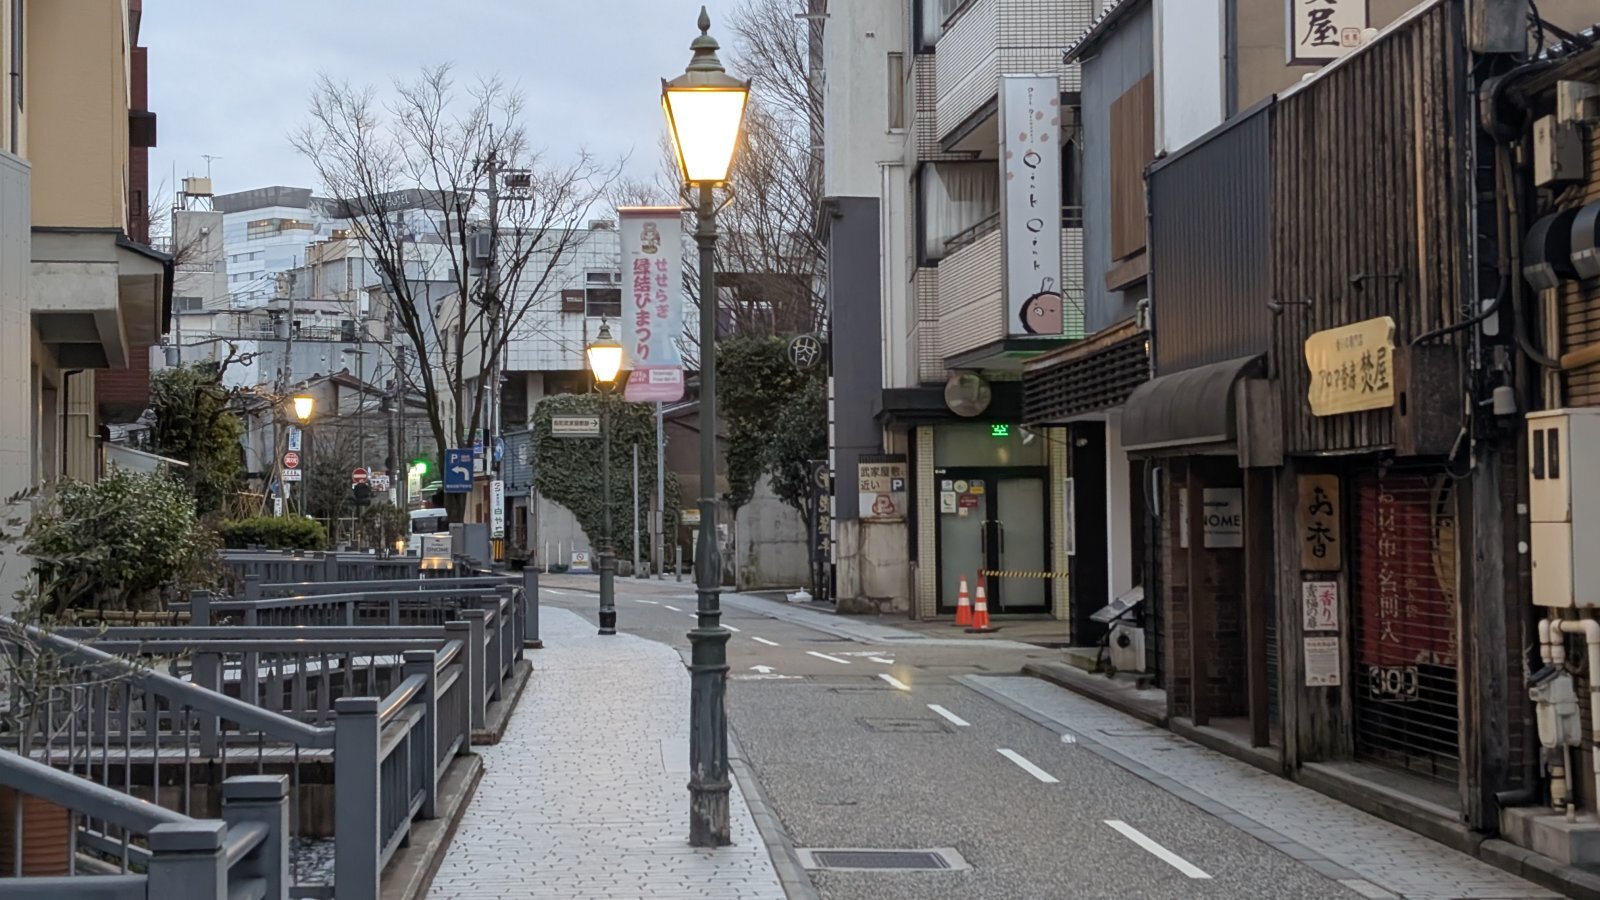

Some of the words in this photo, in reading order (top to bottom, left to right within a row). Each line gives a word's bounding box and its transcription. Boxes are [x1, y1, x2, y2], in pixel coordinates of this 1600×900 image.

[1301, 0, 1340, 46] 屋
[633, 257, 651, 360] 縁結びまつり
[655, 258, 669, 319] せせらぎ
[451, 454, 458, 463] P
[861, 479, 880, 490] 近い
[893, 480, 902, 490] P
[1306, 486, 1336, 558] お香
[1319, 589, 1335, 622] 香り
